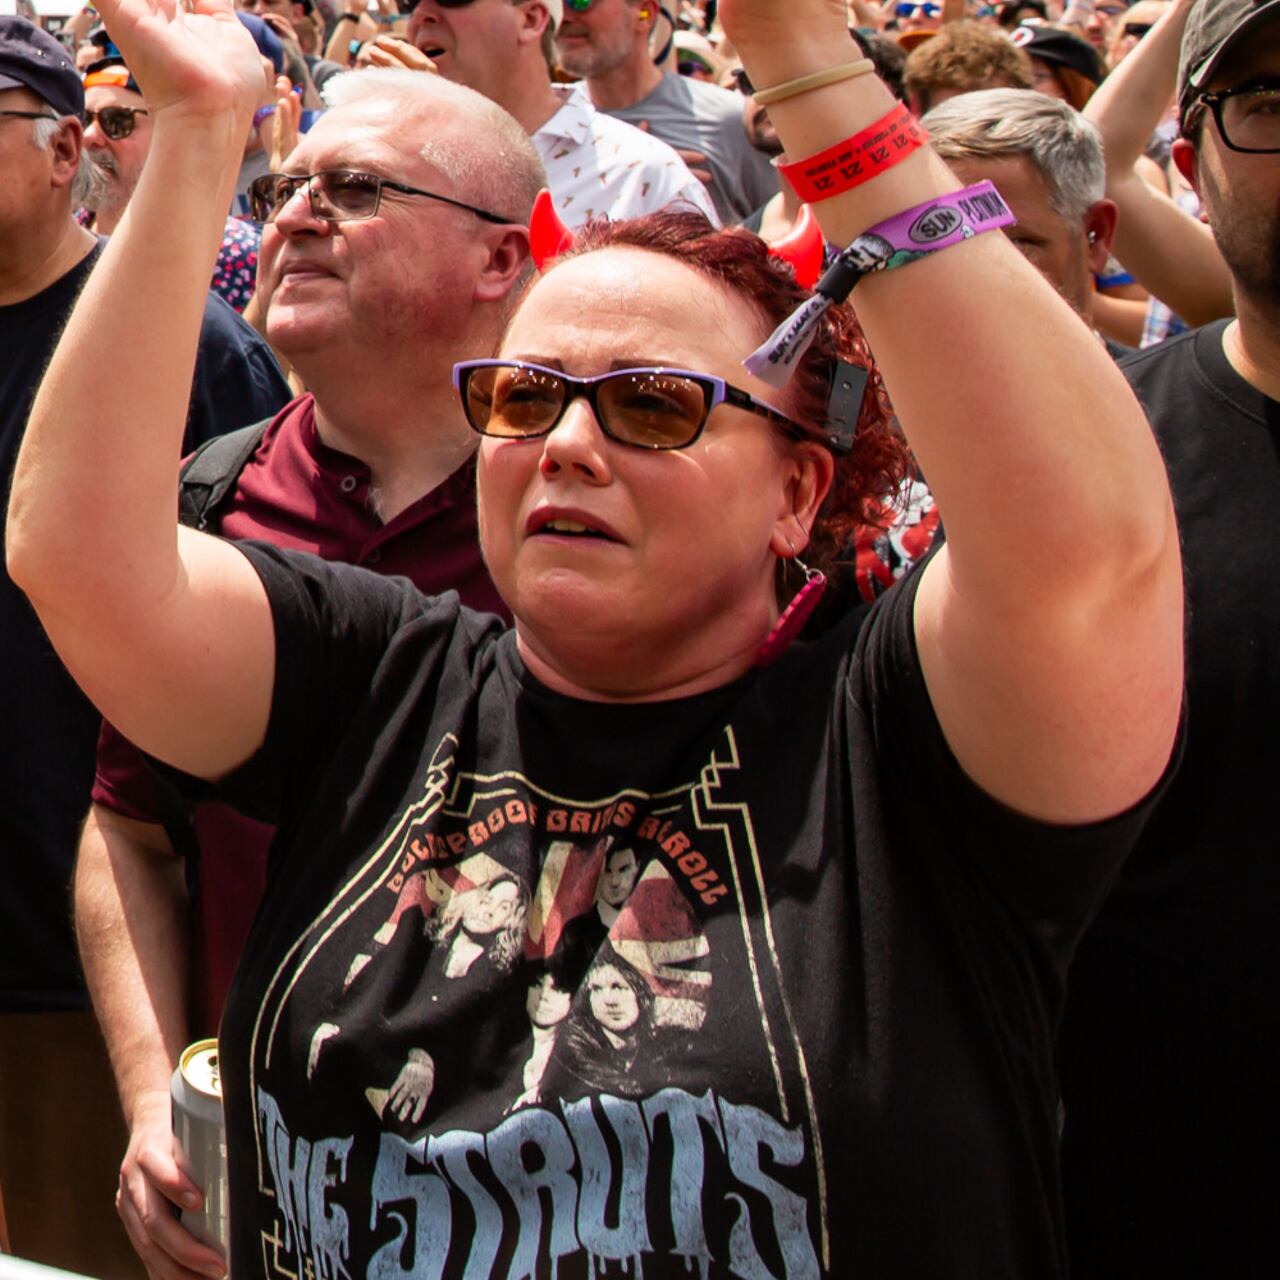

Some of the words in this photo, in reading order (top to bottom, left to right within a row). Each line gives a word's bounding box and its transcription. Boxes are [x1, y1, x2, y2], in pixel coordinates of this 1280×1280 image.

[920, 210, 956, 239] SUN
[257, 1084, 355, 1280] THE
[368, 1086, 820, 1280] STRUTS
